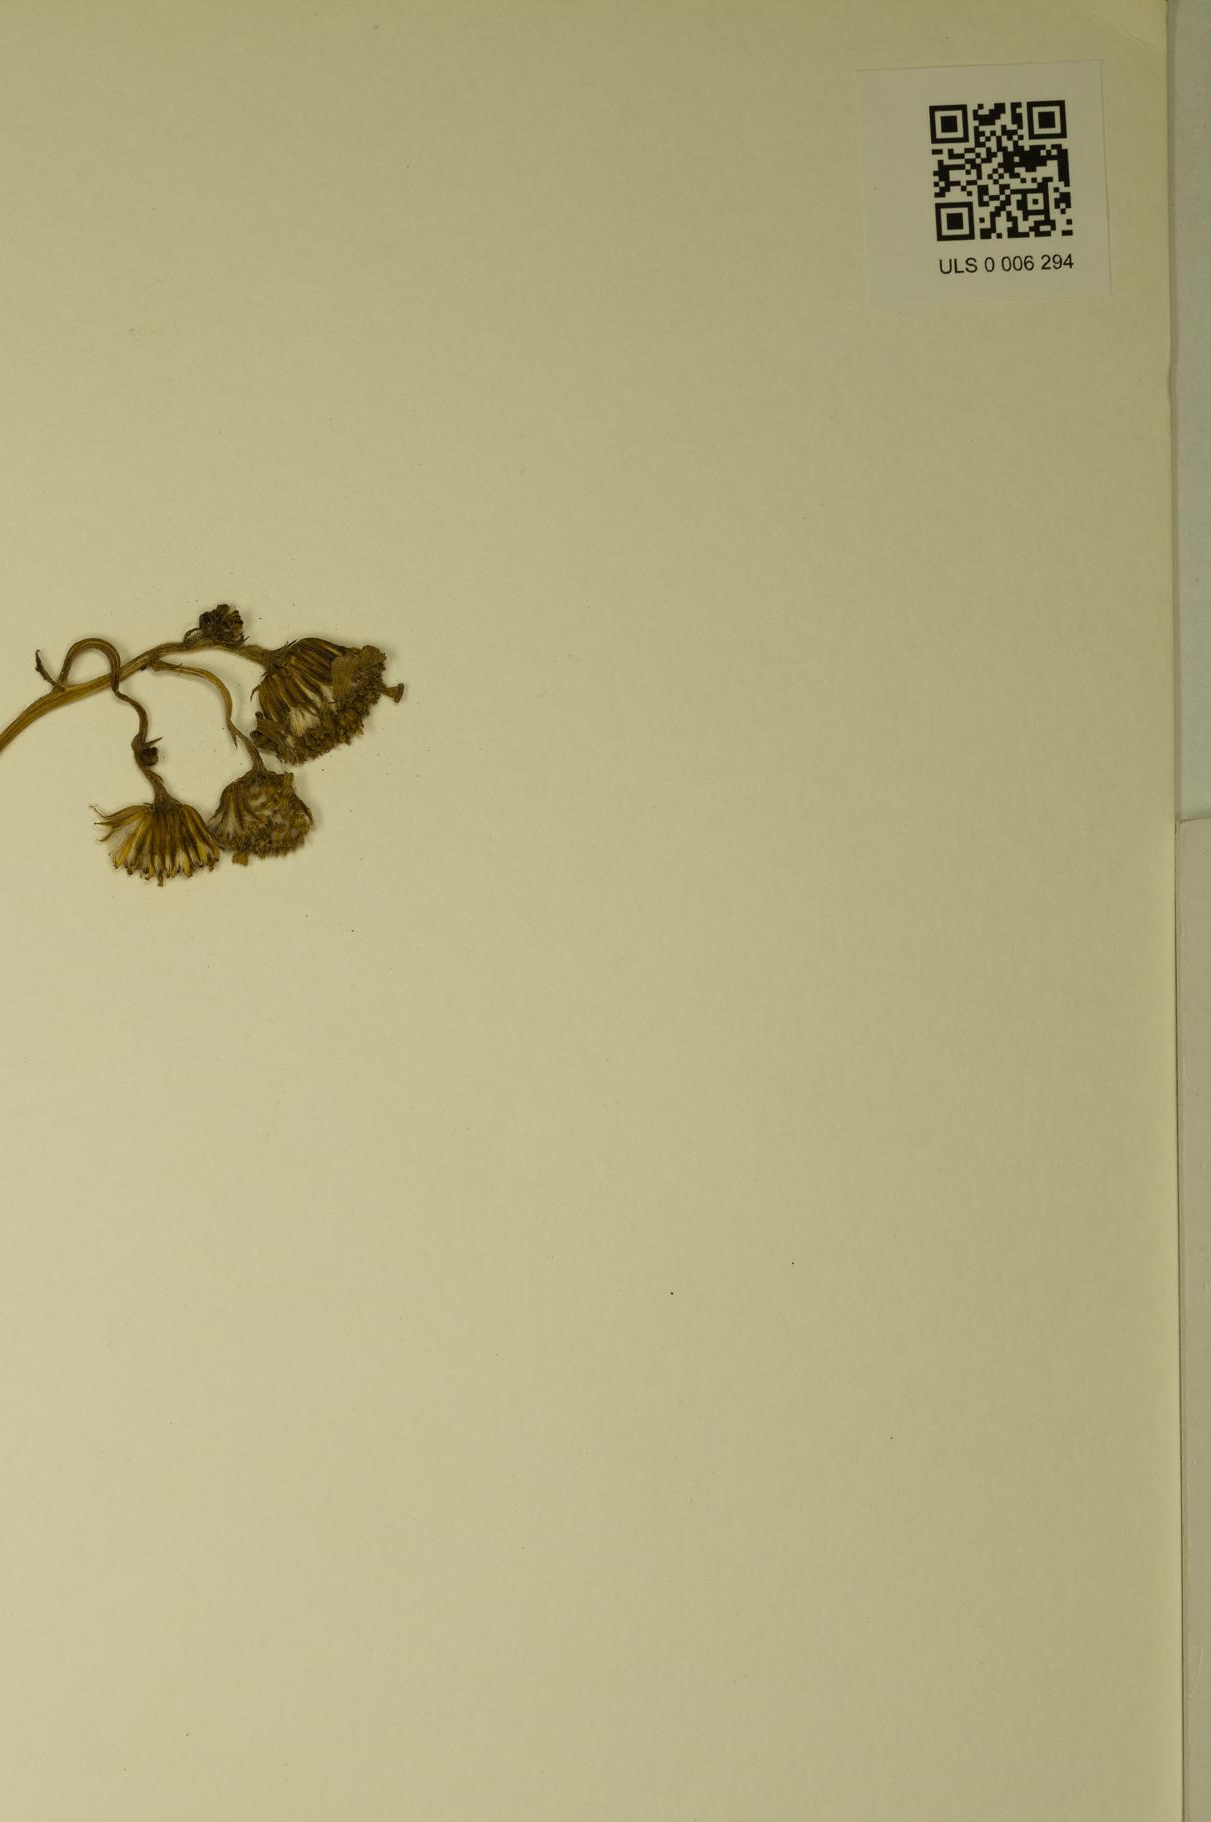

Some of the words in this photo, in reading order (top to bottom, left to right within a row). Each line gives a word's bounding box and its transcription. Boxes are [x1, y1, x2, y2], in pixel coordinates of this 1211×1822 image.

[939, 257, 978, 275] ULS
[984, 256, 996, 273] 0
[1001, 255, 1035, 272] 006
[1040, 253, 1075, 271] 294
